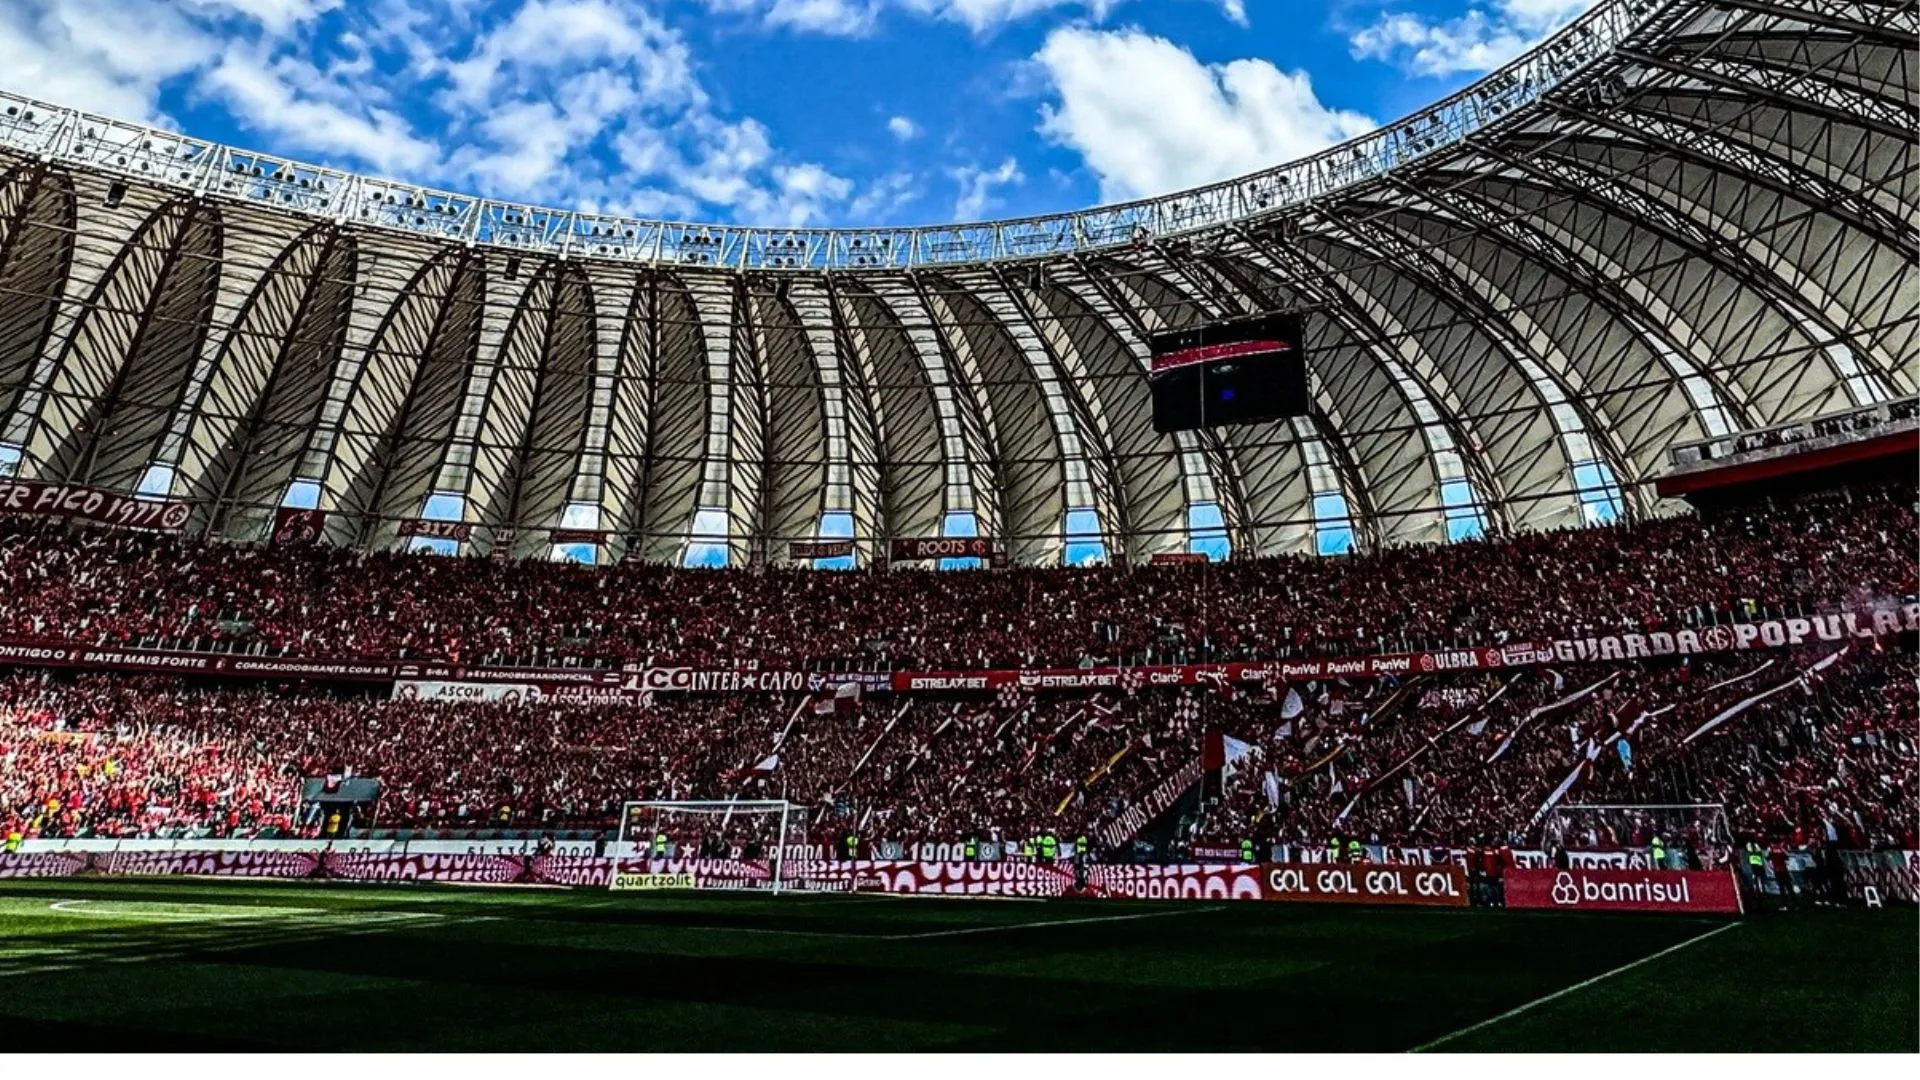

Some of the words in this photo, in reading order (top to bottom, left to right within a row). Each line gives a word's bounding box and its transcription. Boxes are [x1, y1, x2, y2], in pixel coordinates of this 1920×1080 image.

[33, 486, 104, 514] FICO
[105, 498, 163, 525] 1977
[416, 521, 454, 535] 317
[918, 540, 966, 556] ROOTS
[1554, 629, 1702, 662] GUARDA
[84, 651, 123, 663] BATE
[123, 653, 160, 665] MAIS
[161, 656, 207, 668] FORTE
[1372, 658, 1410, 671] PanVel
[1435, 651, 1479, 669] ULBRA
[1283, 663, 1320, 676] PanVel
[1328, 662, 1365, 674] PanVel
[692, 671, 740, 690] INTER
[760, 671, 803, 691] CAPO
[1151, 671, 1179, 684] Claro
[438, 686, 485, 698] ASCOM
[615, 873, 692, 889] quartzolit
[1270, 869, 1309, 893] GOL
[1317, 869, 1358, 894] GOL
[1366, 871, 1408, 896] GOL
[1416, 872, 1460, 897] GOL
[1583, 876, 1690, 903] banrisul
